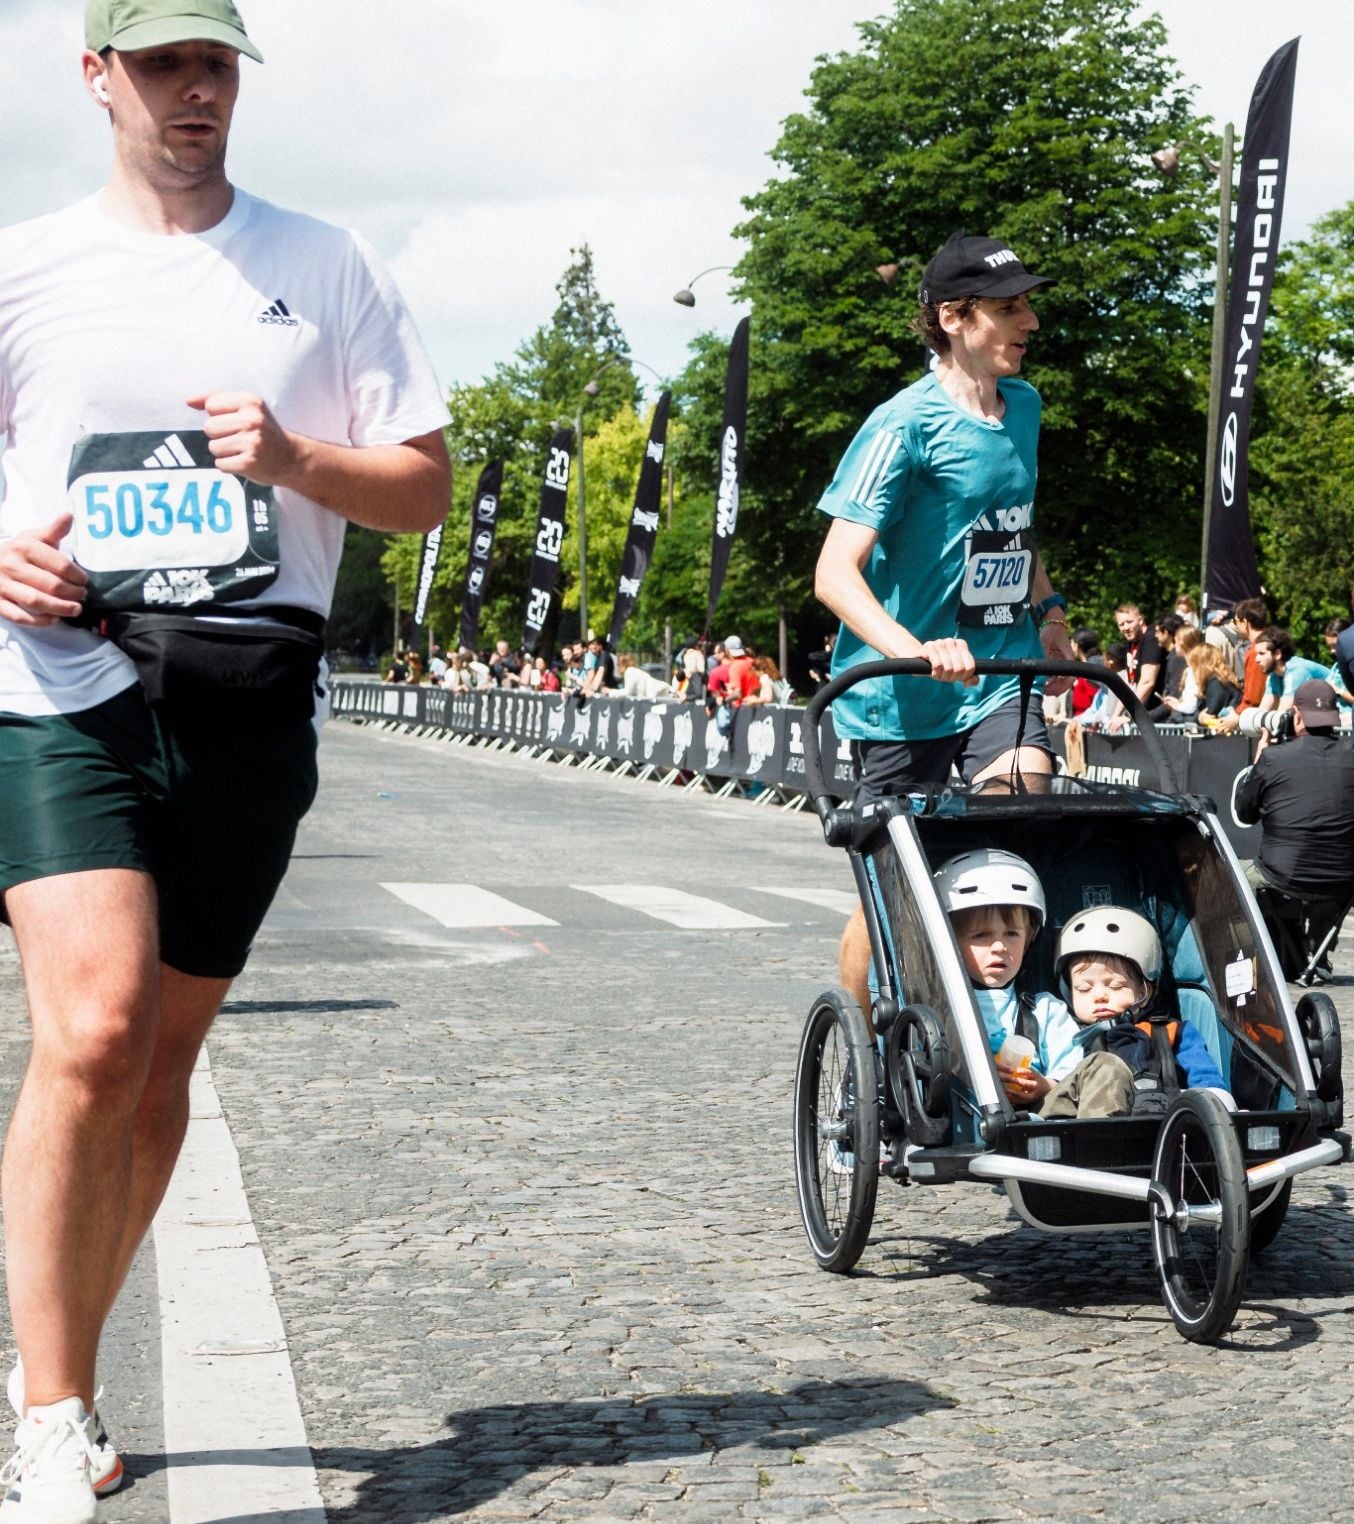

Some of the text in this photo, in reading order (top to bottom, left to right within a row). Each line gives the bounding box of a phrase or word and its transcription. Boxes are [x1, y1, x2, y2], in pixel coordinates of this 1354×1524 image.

[1230, 158, 1279, 398] HYUNDAI
[257, 315, 299, 326] adidas
[85, 480, 233, 539] 50346
[414, 524, 443, 625] COSMOPOLITA
[973, 555, 1026, 589] 57120
[983, 614, 1014, 625] PARIS
